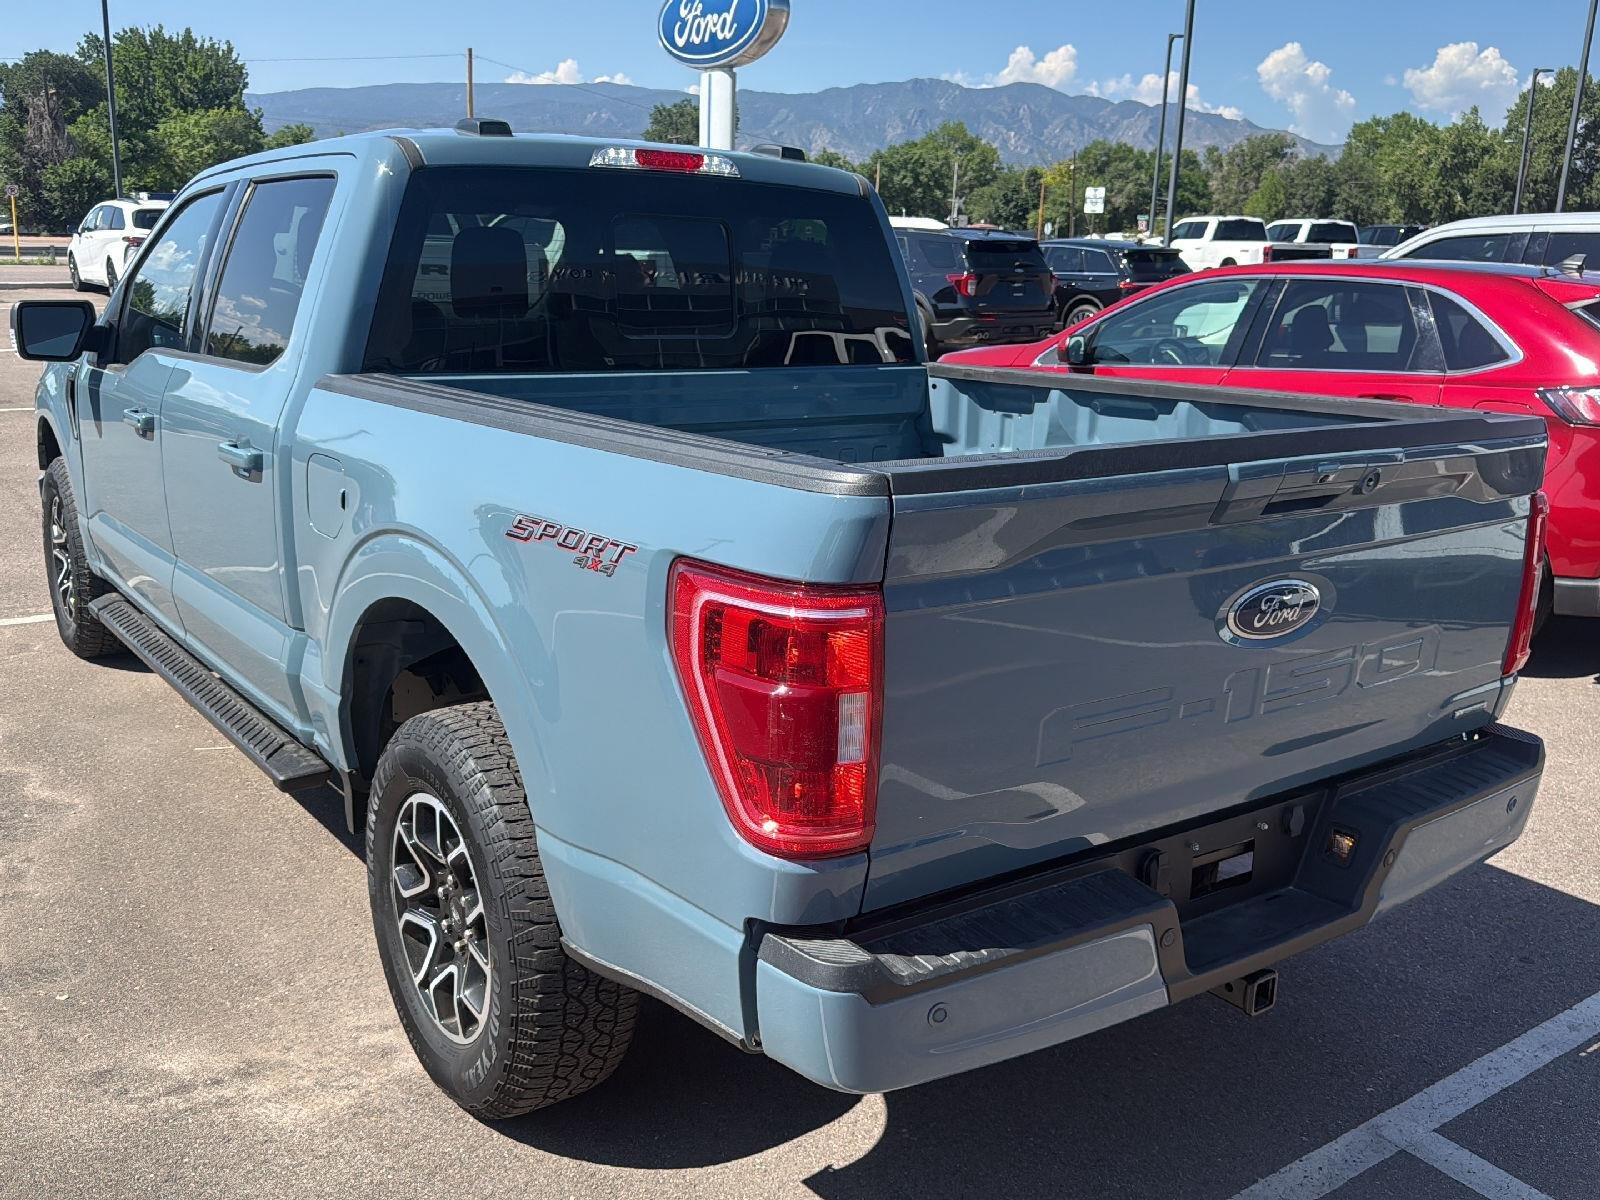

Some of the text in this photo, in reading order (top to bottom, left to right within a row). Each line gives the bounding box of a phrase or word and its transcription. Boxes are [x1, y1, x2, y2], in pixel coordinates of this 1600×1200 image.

[674, 0, 738, 48] Ford
[505, 513, 640, 564] SPORT
[1253, 589, 1304, 628] Ford
[1036, 624, 1440, 768] F-150
